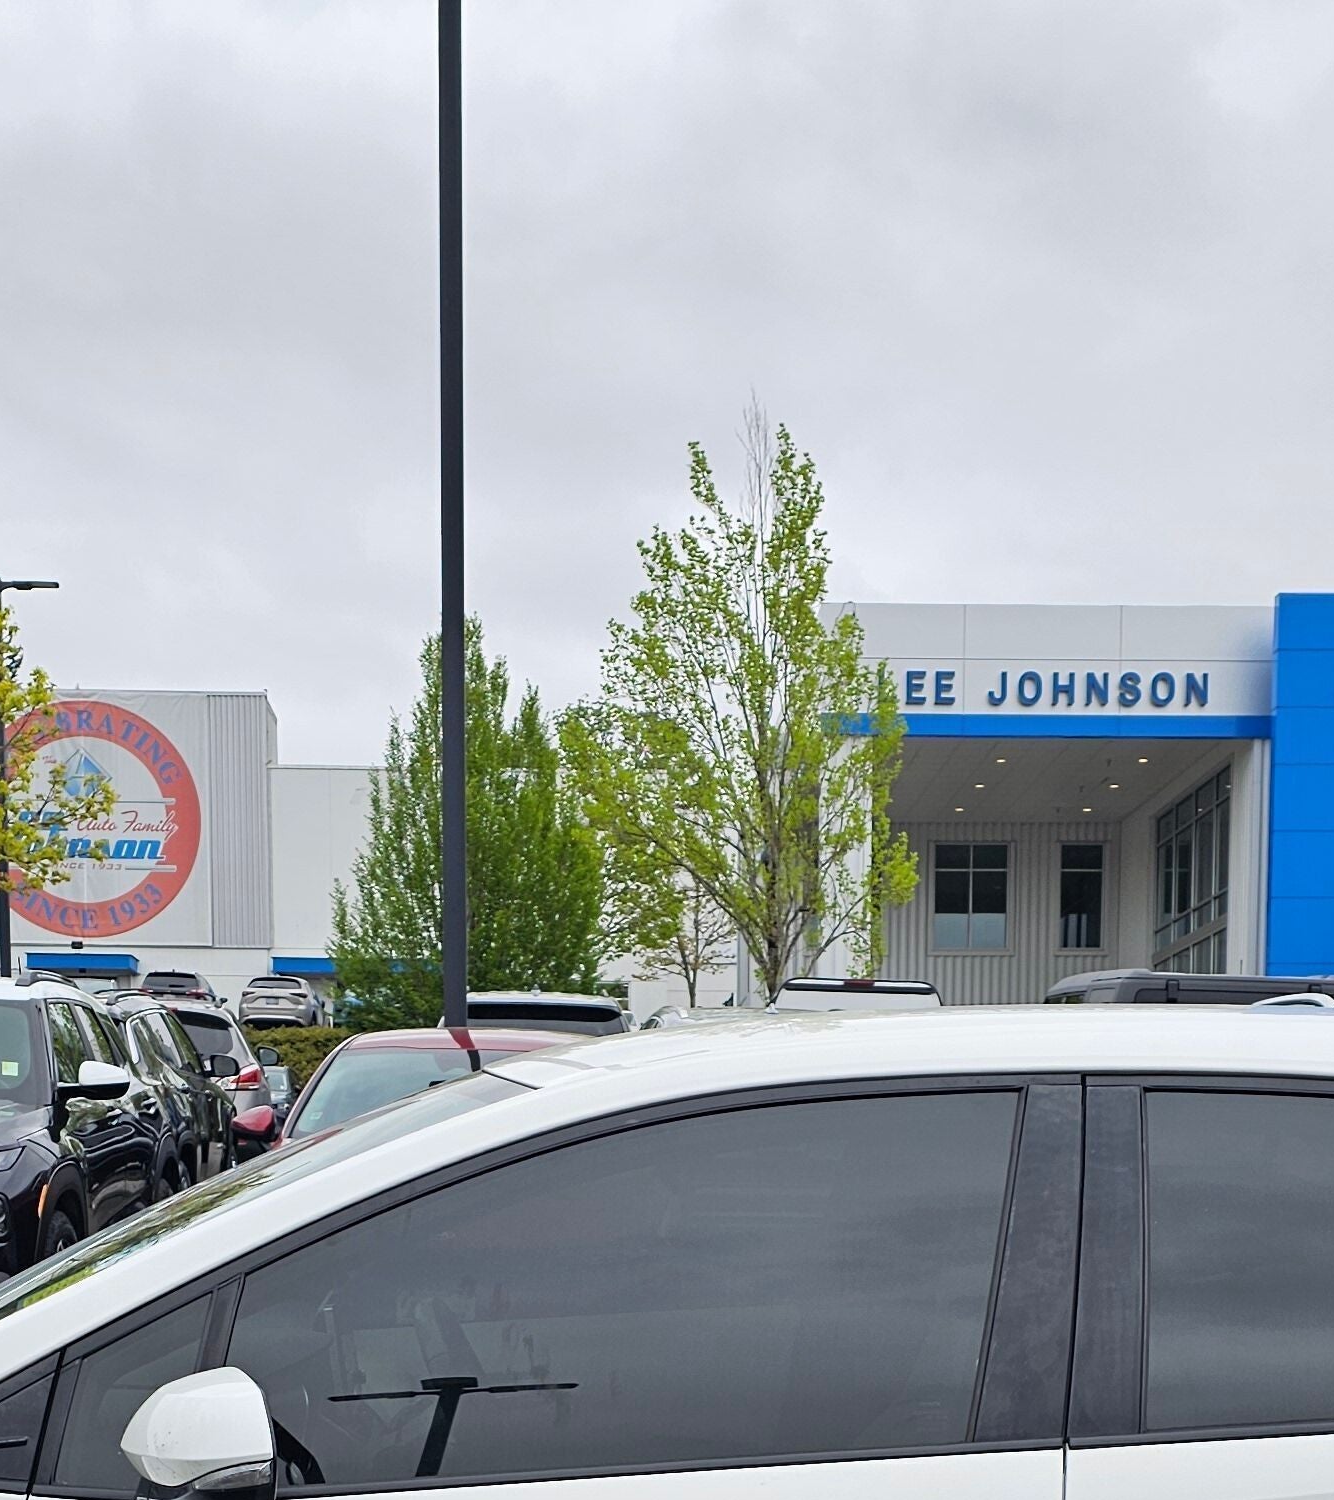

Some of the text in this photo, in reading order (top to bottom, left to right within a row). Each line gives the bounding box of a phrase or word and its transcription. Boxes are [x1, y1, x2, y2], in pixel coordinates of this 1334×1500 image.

[987, 671, 1209, 708] JOHNSON
[35, 709, 182, 784] BRATING
[77, 810, 179, 841] Auto Family
[107, 883, 163, 926] 1933
